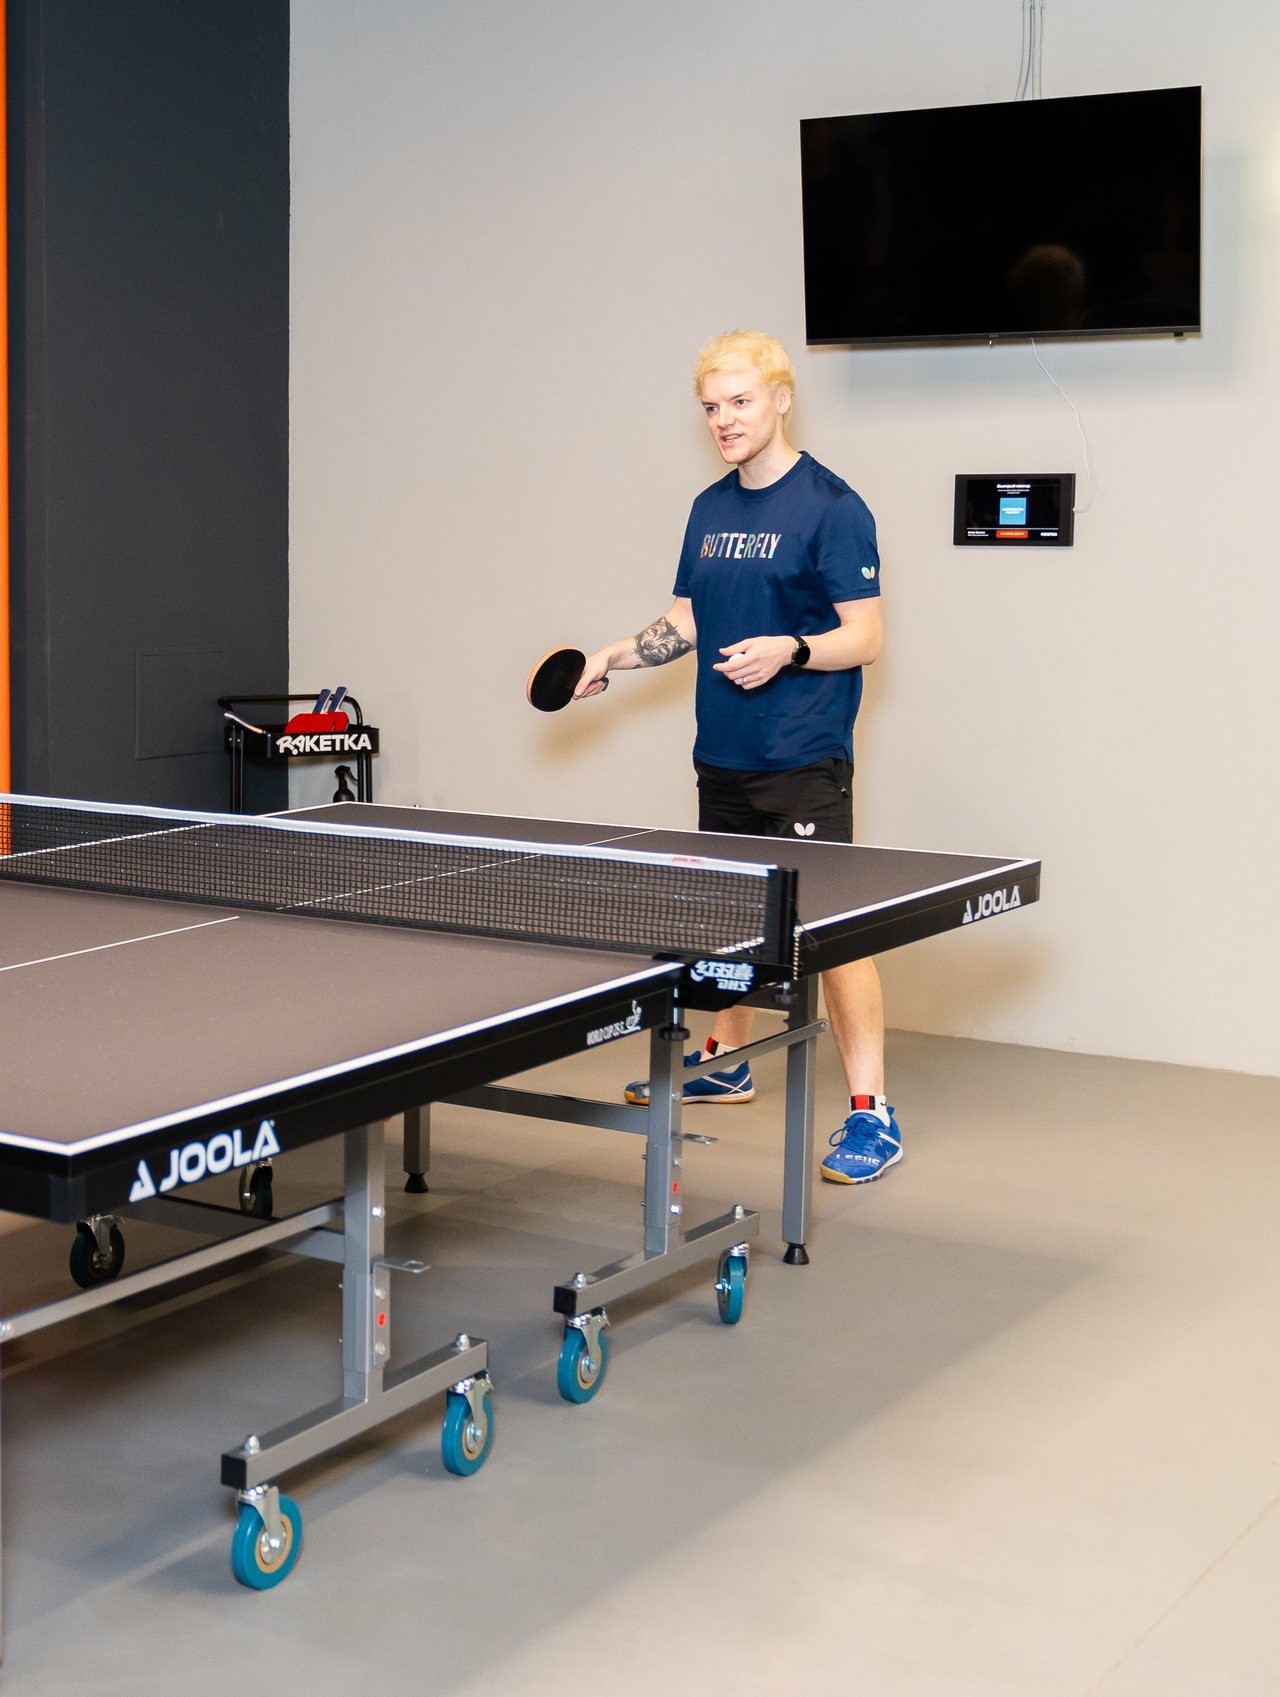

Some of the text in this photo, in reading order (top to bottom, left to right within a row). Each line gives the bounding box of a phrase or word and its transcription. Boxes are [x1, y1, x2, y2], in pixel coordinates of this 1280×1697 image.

[700, 533, 782, 559] BUTTERFLY
[276, 733, 372, 755] RAKETKA
[974, 885, 1021, 920] JOOLA
[159, 1119, 281, 1192] JOOLA
